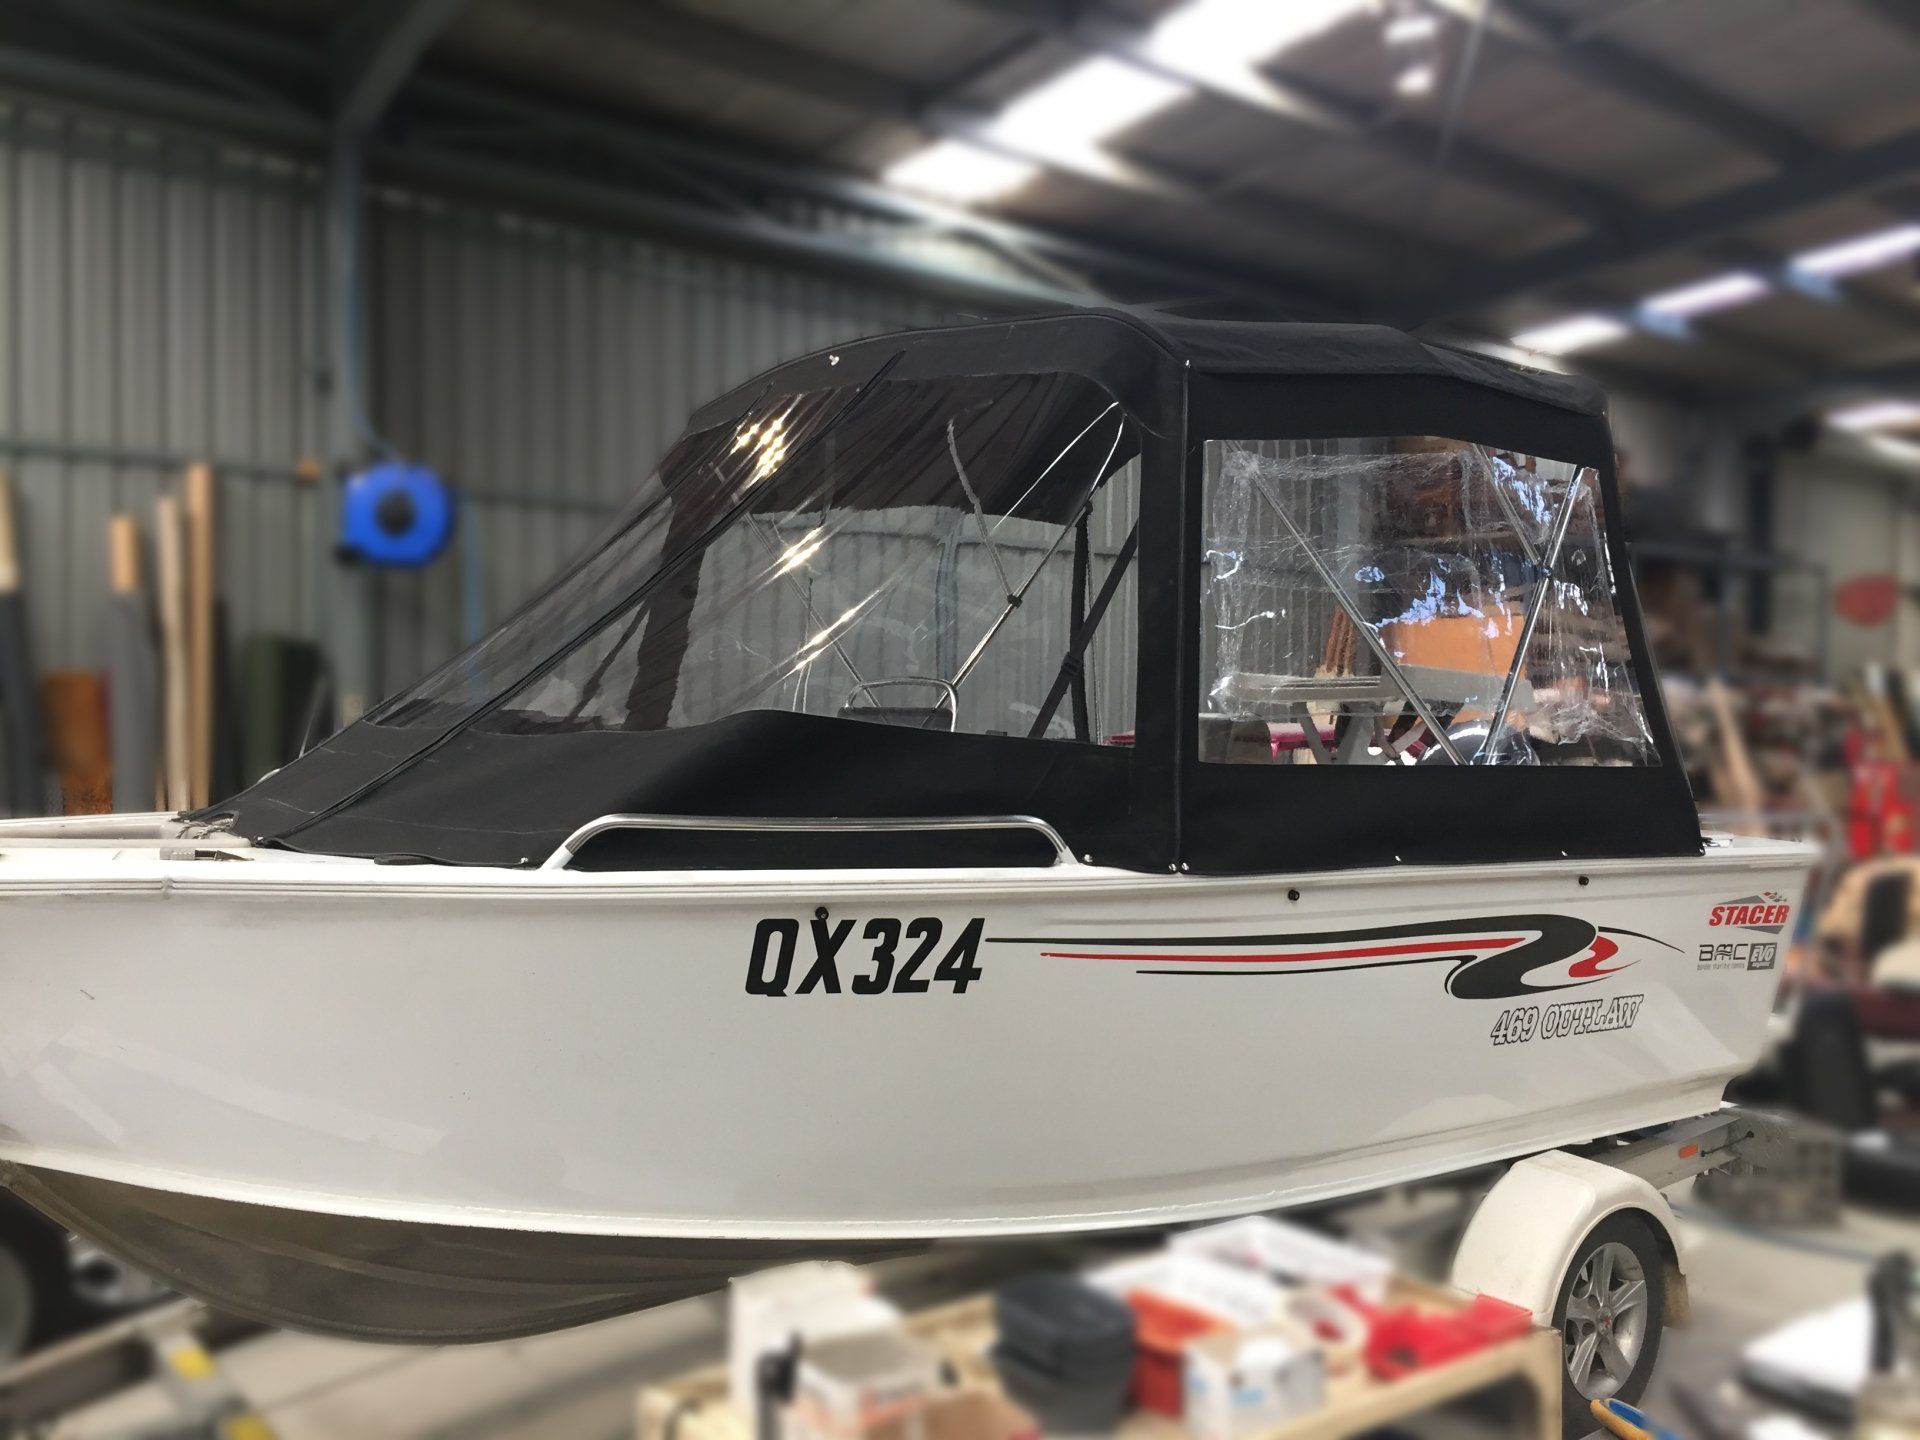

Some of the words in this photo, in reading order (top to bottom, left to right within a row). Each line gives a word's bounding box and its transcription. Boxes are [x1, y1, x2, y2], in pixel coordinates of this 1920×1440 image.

[1708, 905, 1790, 926] STACER
[745, 917, 985, 997] QX324
[1699, 943, 1748, 961] BMC
[1750, 945, 1775, 962] EVO
[1490, 1005, 1540, 1046] 469
[1541, 994, 1644, 1039] OUTLAW
